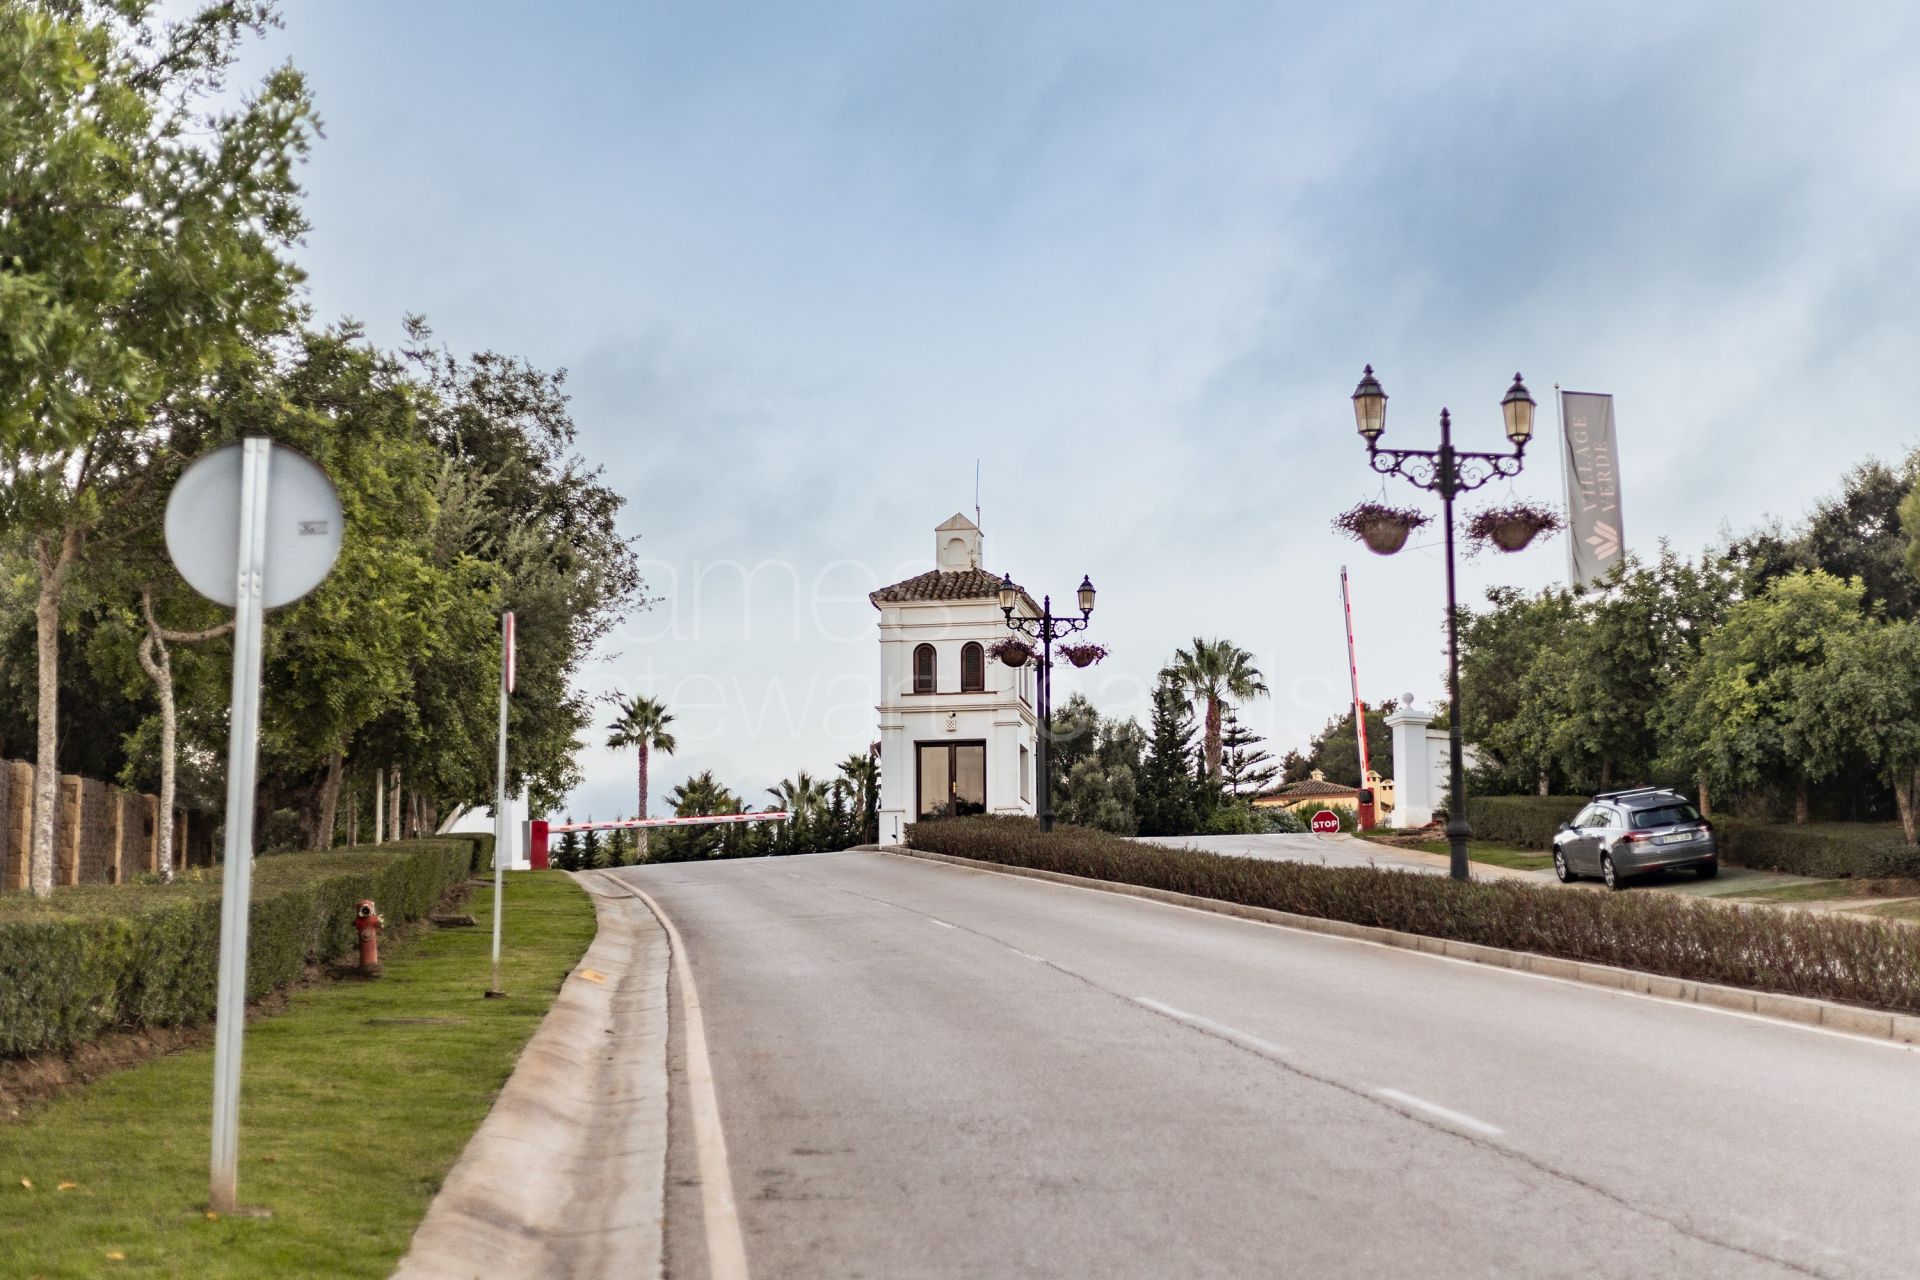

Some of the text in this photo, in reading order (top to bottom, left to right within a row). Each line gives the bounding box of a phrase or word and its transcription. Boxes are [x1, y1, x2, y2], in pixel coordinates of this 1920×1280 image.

[1572, 416, 1597, 512] VILLAGE
[1594, 440, 1616, 512] VERDE
[1313, 820, 1337, 829] STOP
